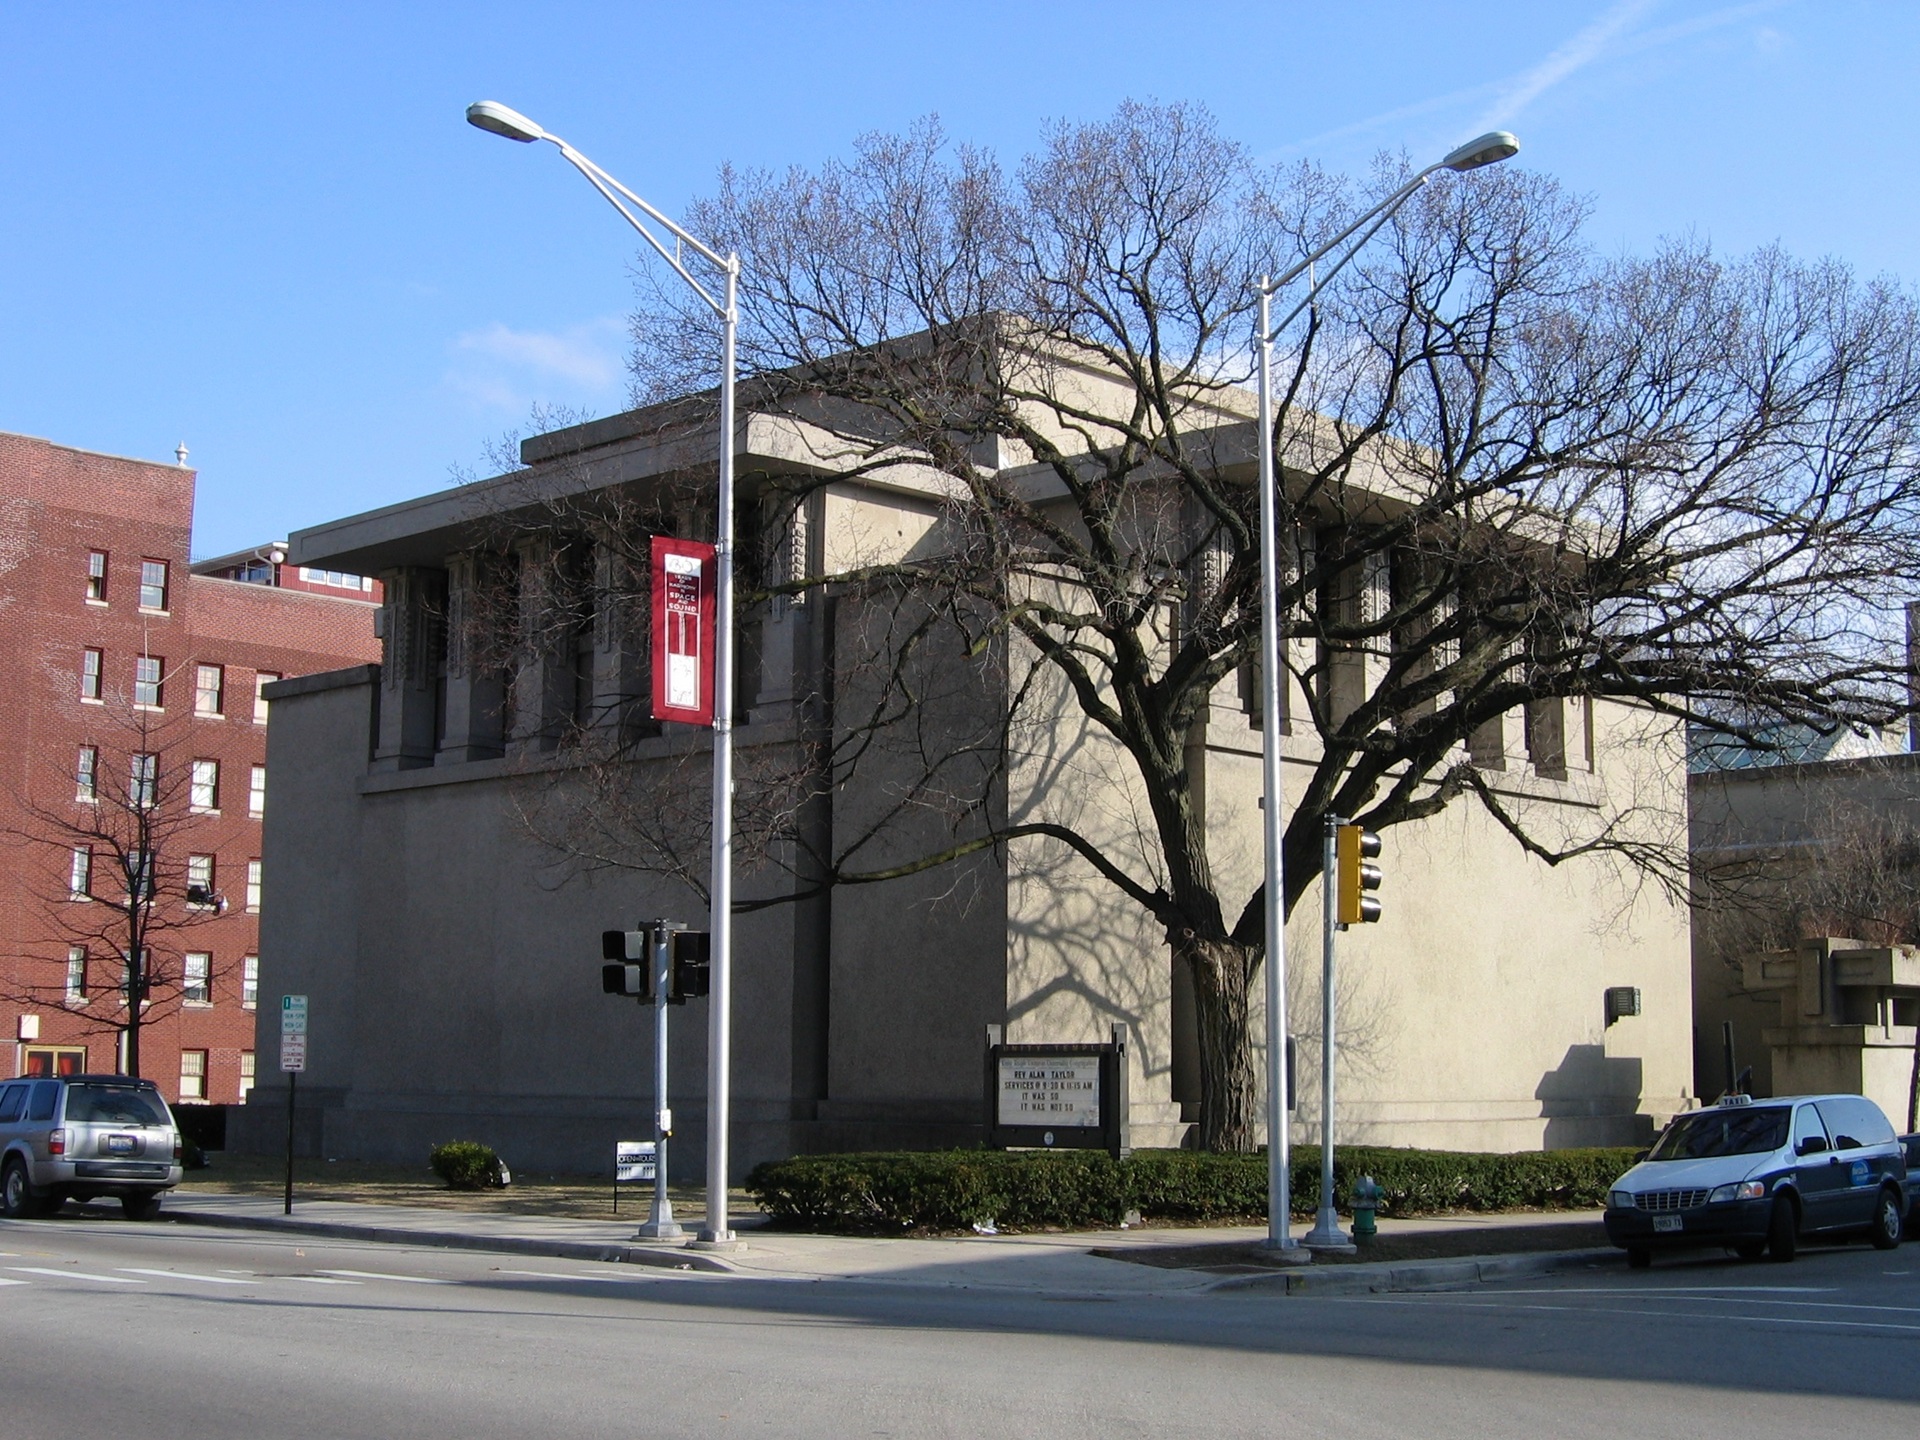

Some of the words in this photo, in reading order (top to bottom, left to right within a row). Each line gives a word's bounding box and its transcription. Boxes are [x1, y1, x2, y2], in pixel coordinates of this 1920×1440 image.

[669, 591, 696, 602] SPACE
[668, 602, 697, 613] SOUND
[1014, 1071, 1026, 1079] REV
[1028, 1071, 1045, 1079] ALAN
[1051, 1071, 1075, 1079] TAYLOR
[1004, 1081, 1034, 1090] SERVICES
[1083, 1081, 1093, 1090] AM
[1022, 1092, 1028, 1100] IT
[1032, 1092, 1046, 1100] WAS
[1050, 1092, 1059, 1100] SO
[1724, 1097, 1743, 1105] TAXI
[1020, 1103, 1028, 1111] IT
[1032, 1103, 1045, 1111] WAS
[1050, 1103, 1062, 1111] NOT
[1065, 1103, 1074, 1111] SO
